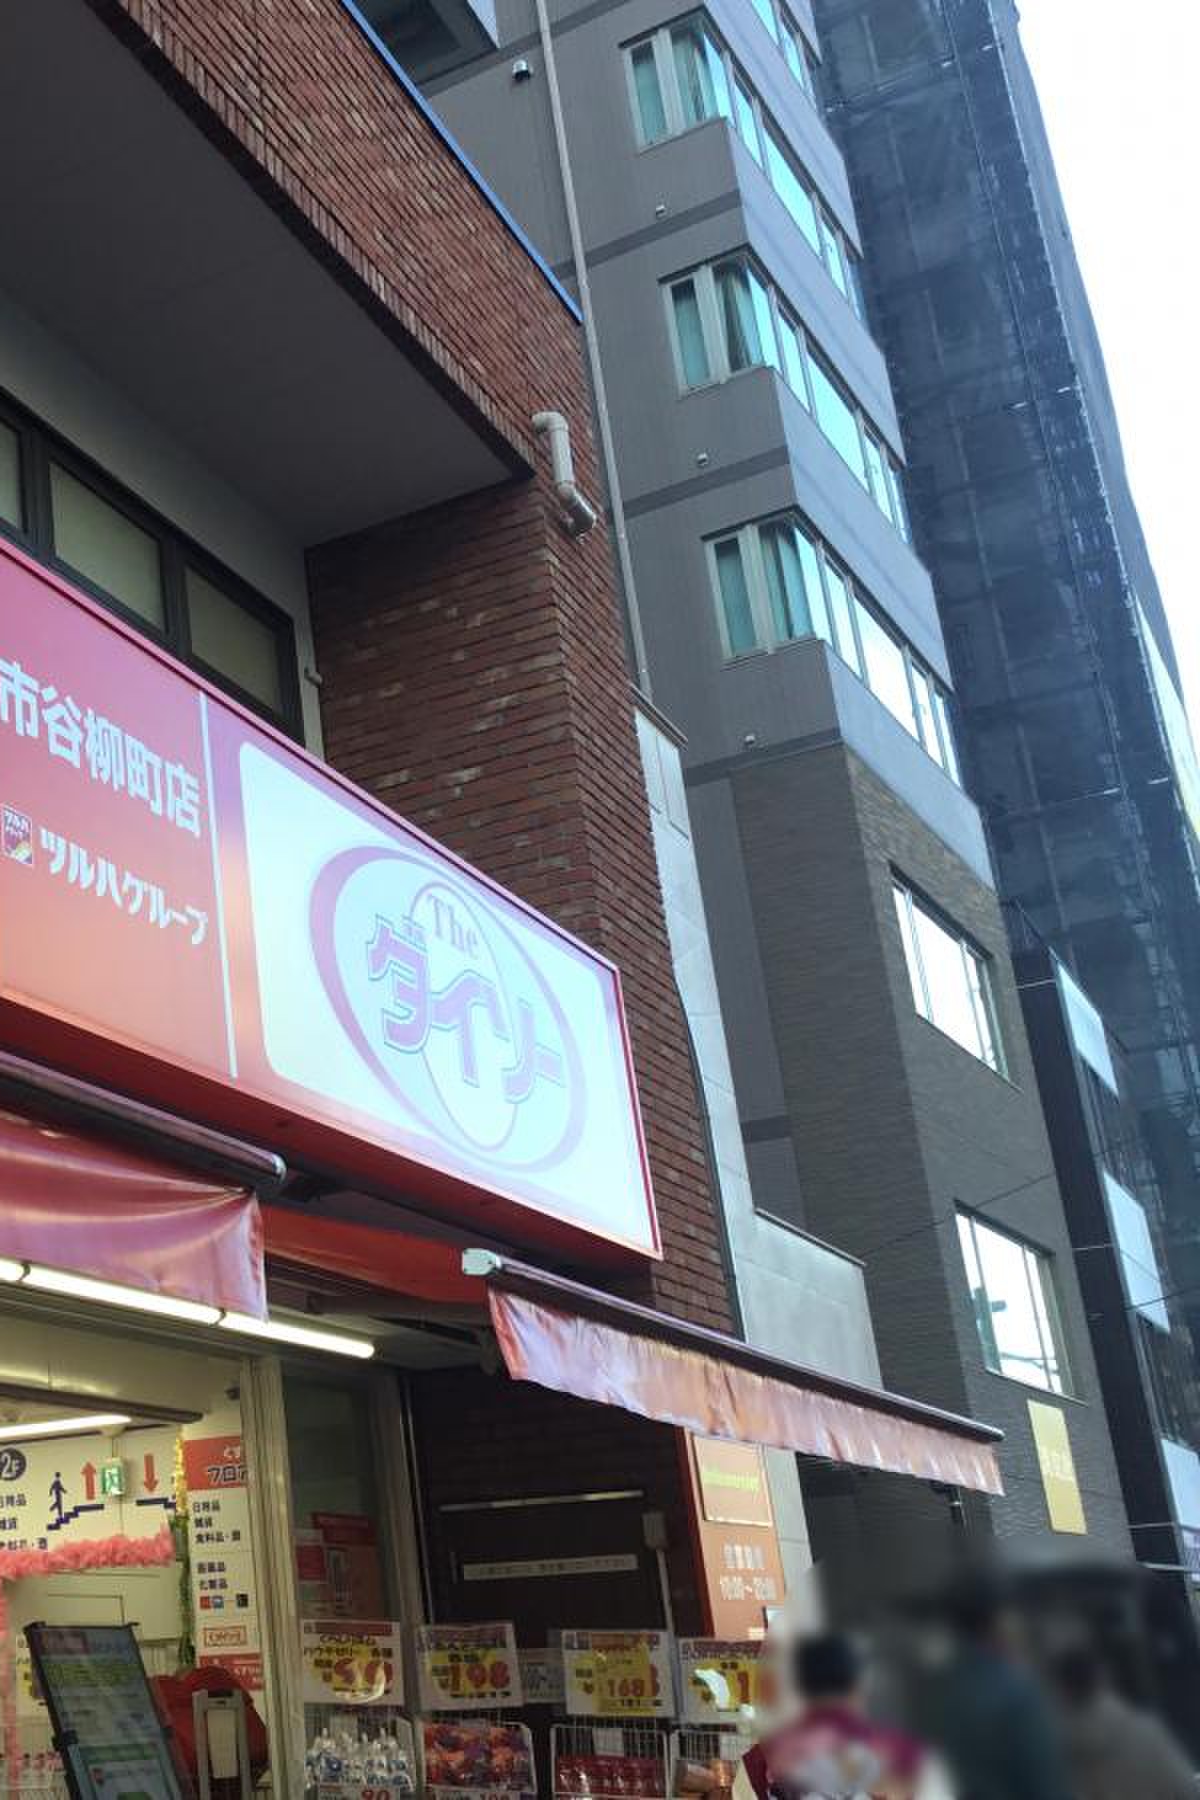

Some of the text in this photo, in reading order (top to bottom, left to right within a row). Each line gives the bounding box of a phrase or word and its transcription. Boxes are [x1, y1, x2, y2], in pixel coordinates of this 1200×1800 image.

[39, 827, 208, 945] ツルハグループ
[426, 893, 480, 959] The
